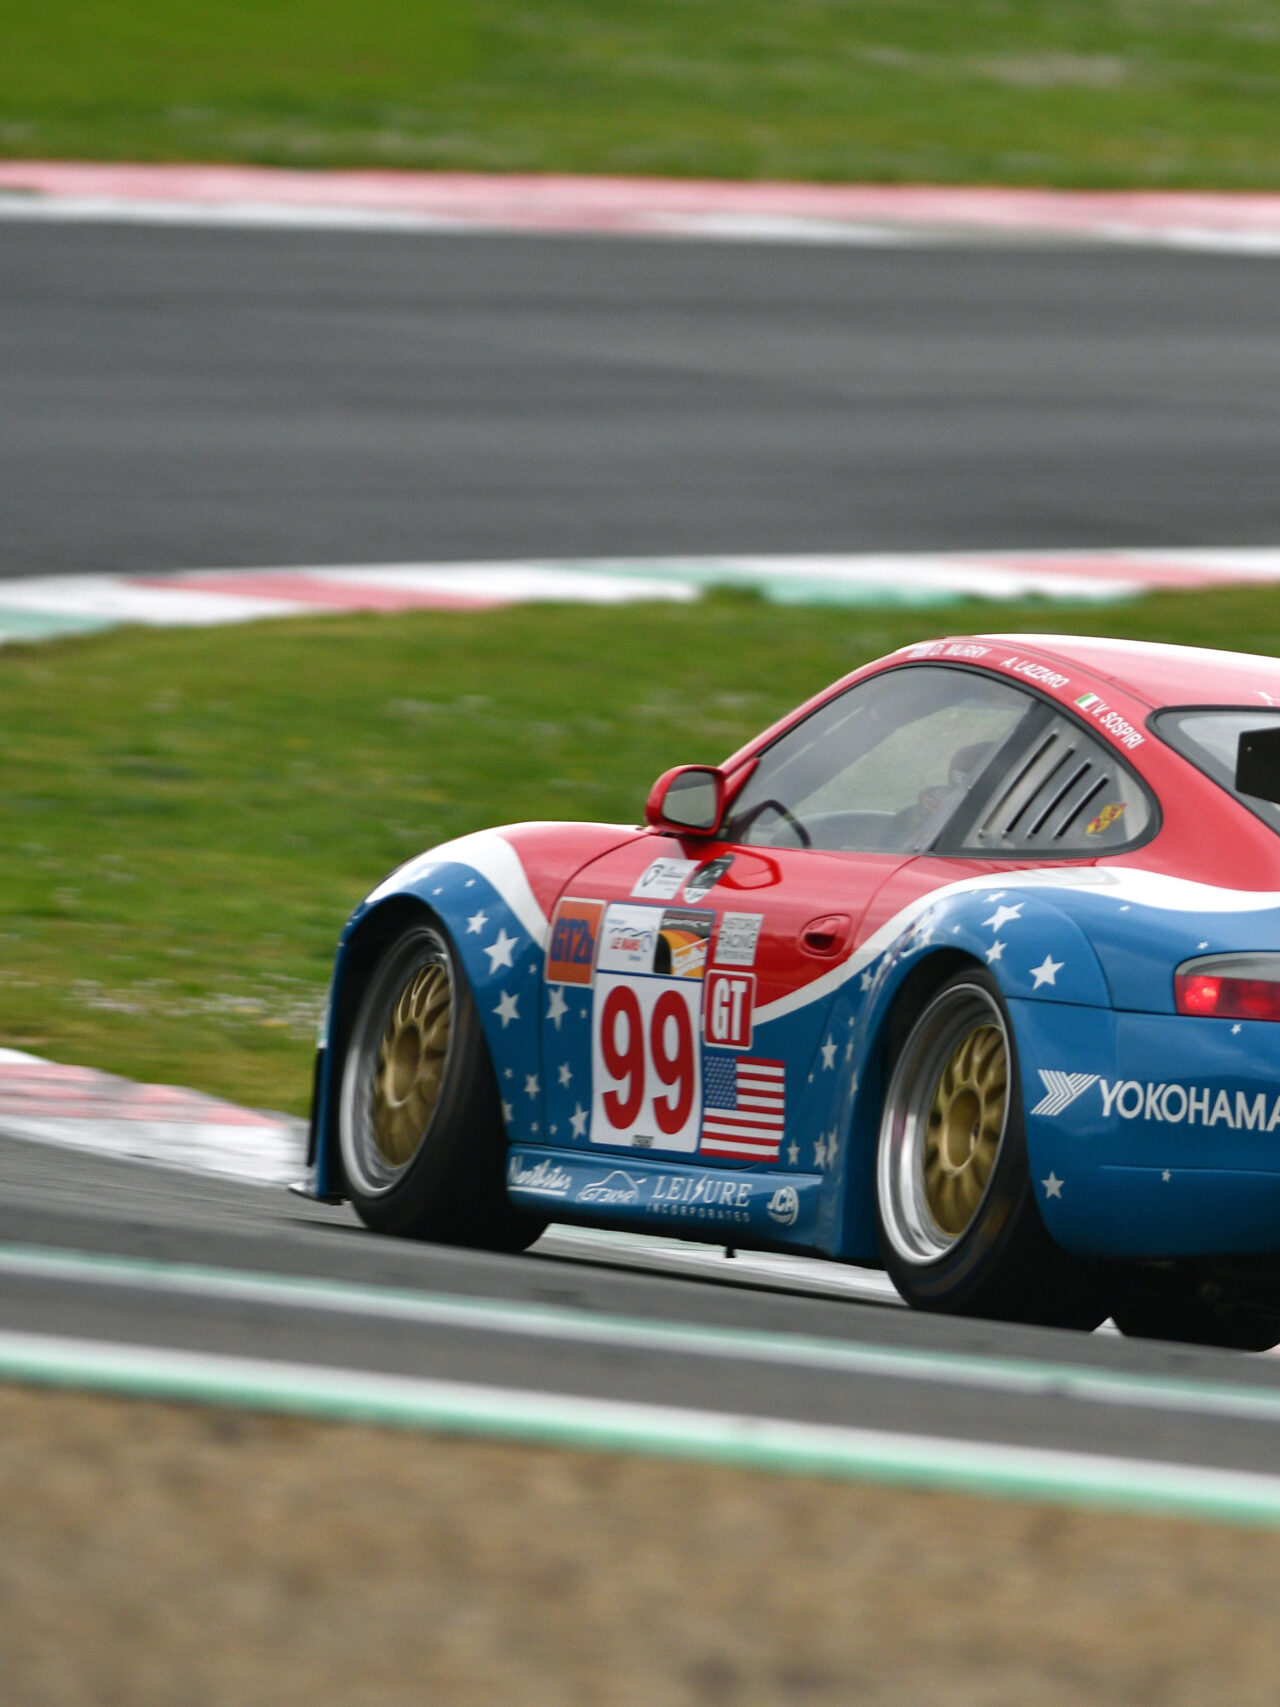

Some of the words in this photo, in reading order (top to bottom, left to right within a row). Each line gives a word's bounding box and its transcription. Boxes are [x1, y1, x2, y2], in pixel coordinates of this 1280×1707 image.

[1013, 660, 1070, 689] LAZZARO
[1092, 702, 1102, 718] V.
[1100, 711, 1146, 750] SOSPIRI
[712, 978, 748, 1041] GT
[601, 985, 694, 1135] 99
